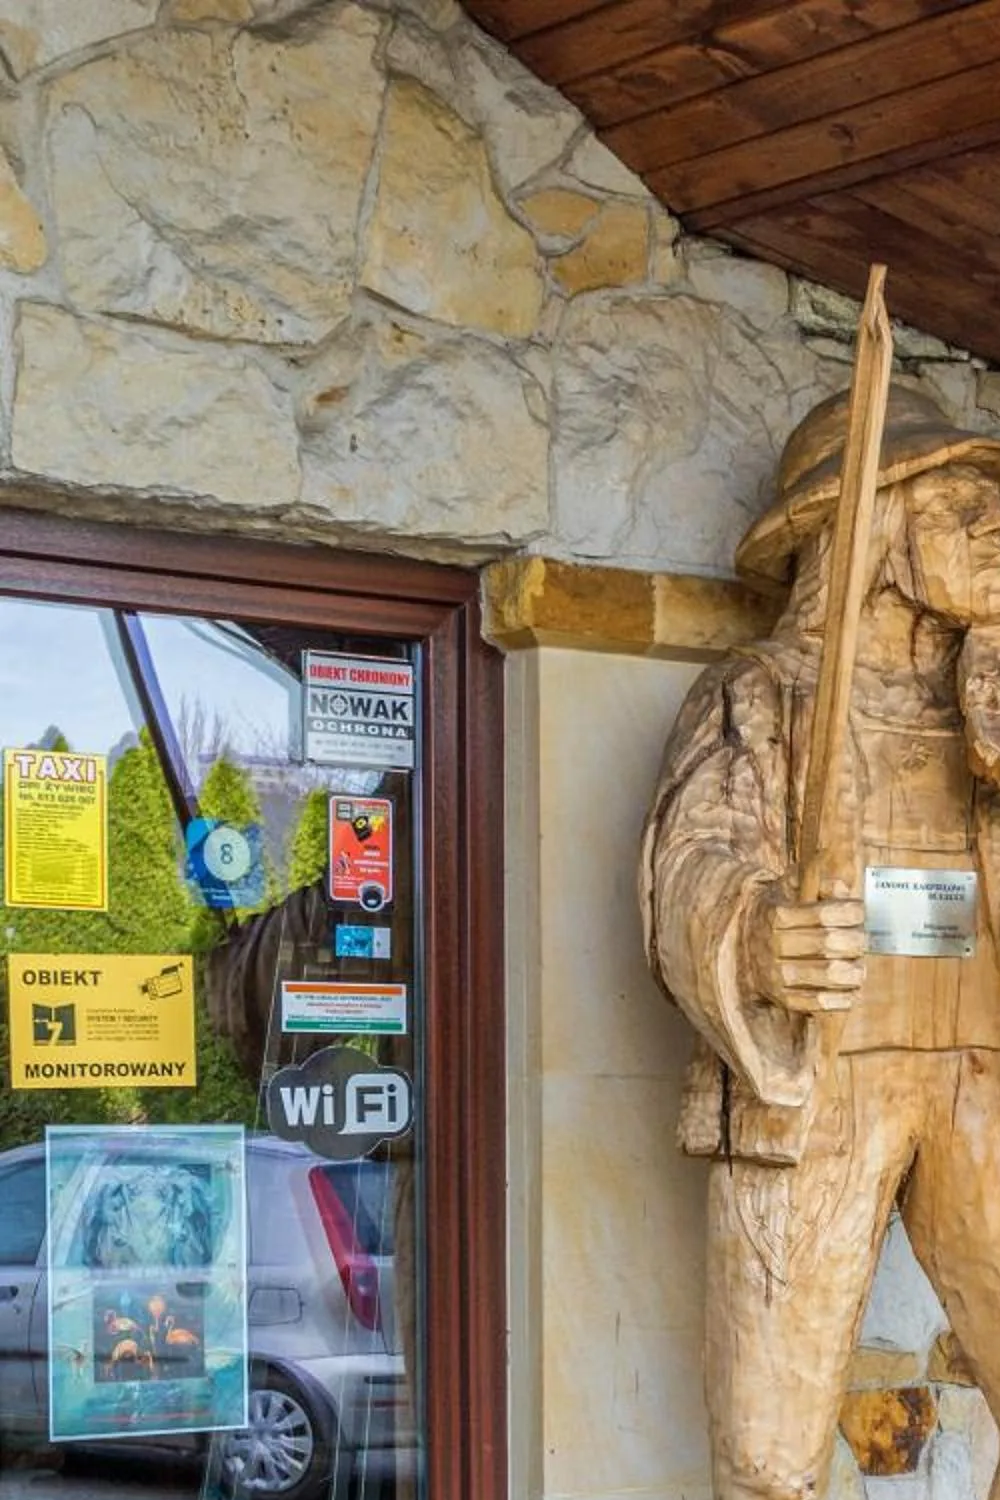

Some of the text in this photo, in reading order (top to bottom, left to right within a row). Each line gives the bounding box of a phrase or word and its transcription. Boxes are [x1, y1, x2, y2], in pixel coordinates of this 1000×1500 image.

[310, 664, 410, 686] OBIEKT CHRONIONY
[310, 693, 408, 721] NOWAK
[312, 720, 408, 737] OCHRONA
[14, 753, 96, 784] TAXI
[220, 843, 233, 865] 8
[22, 969, 102, 986] OBIEKT
[24, 1061, 187, 1079] MONITOROWANY
